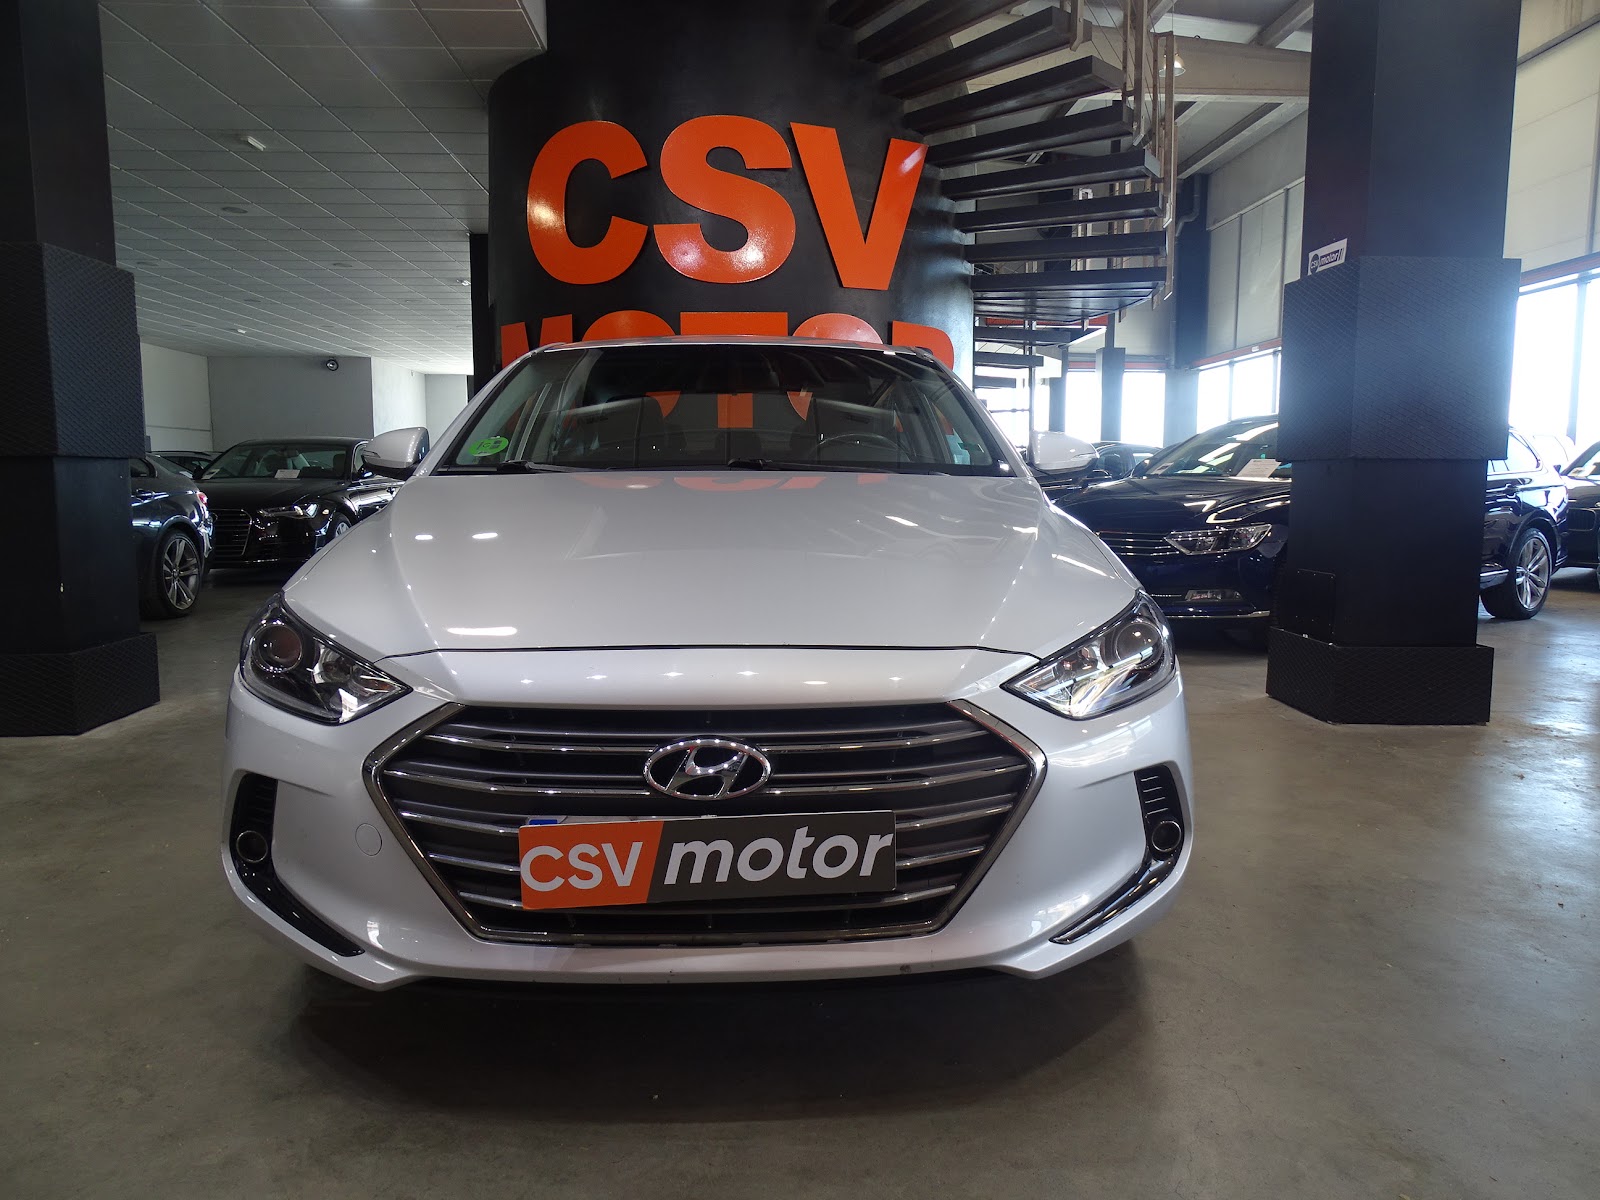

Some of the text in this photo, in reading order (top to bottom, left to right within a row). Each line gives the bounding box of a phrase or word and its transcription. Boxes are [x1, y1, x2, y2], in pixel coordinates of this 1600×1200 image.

[527, 115, 929, 291] CSV
[520, 825, 894, 892] CSV motor
